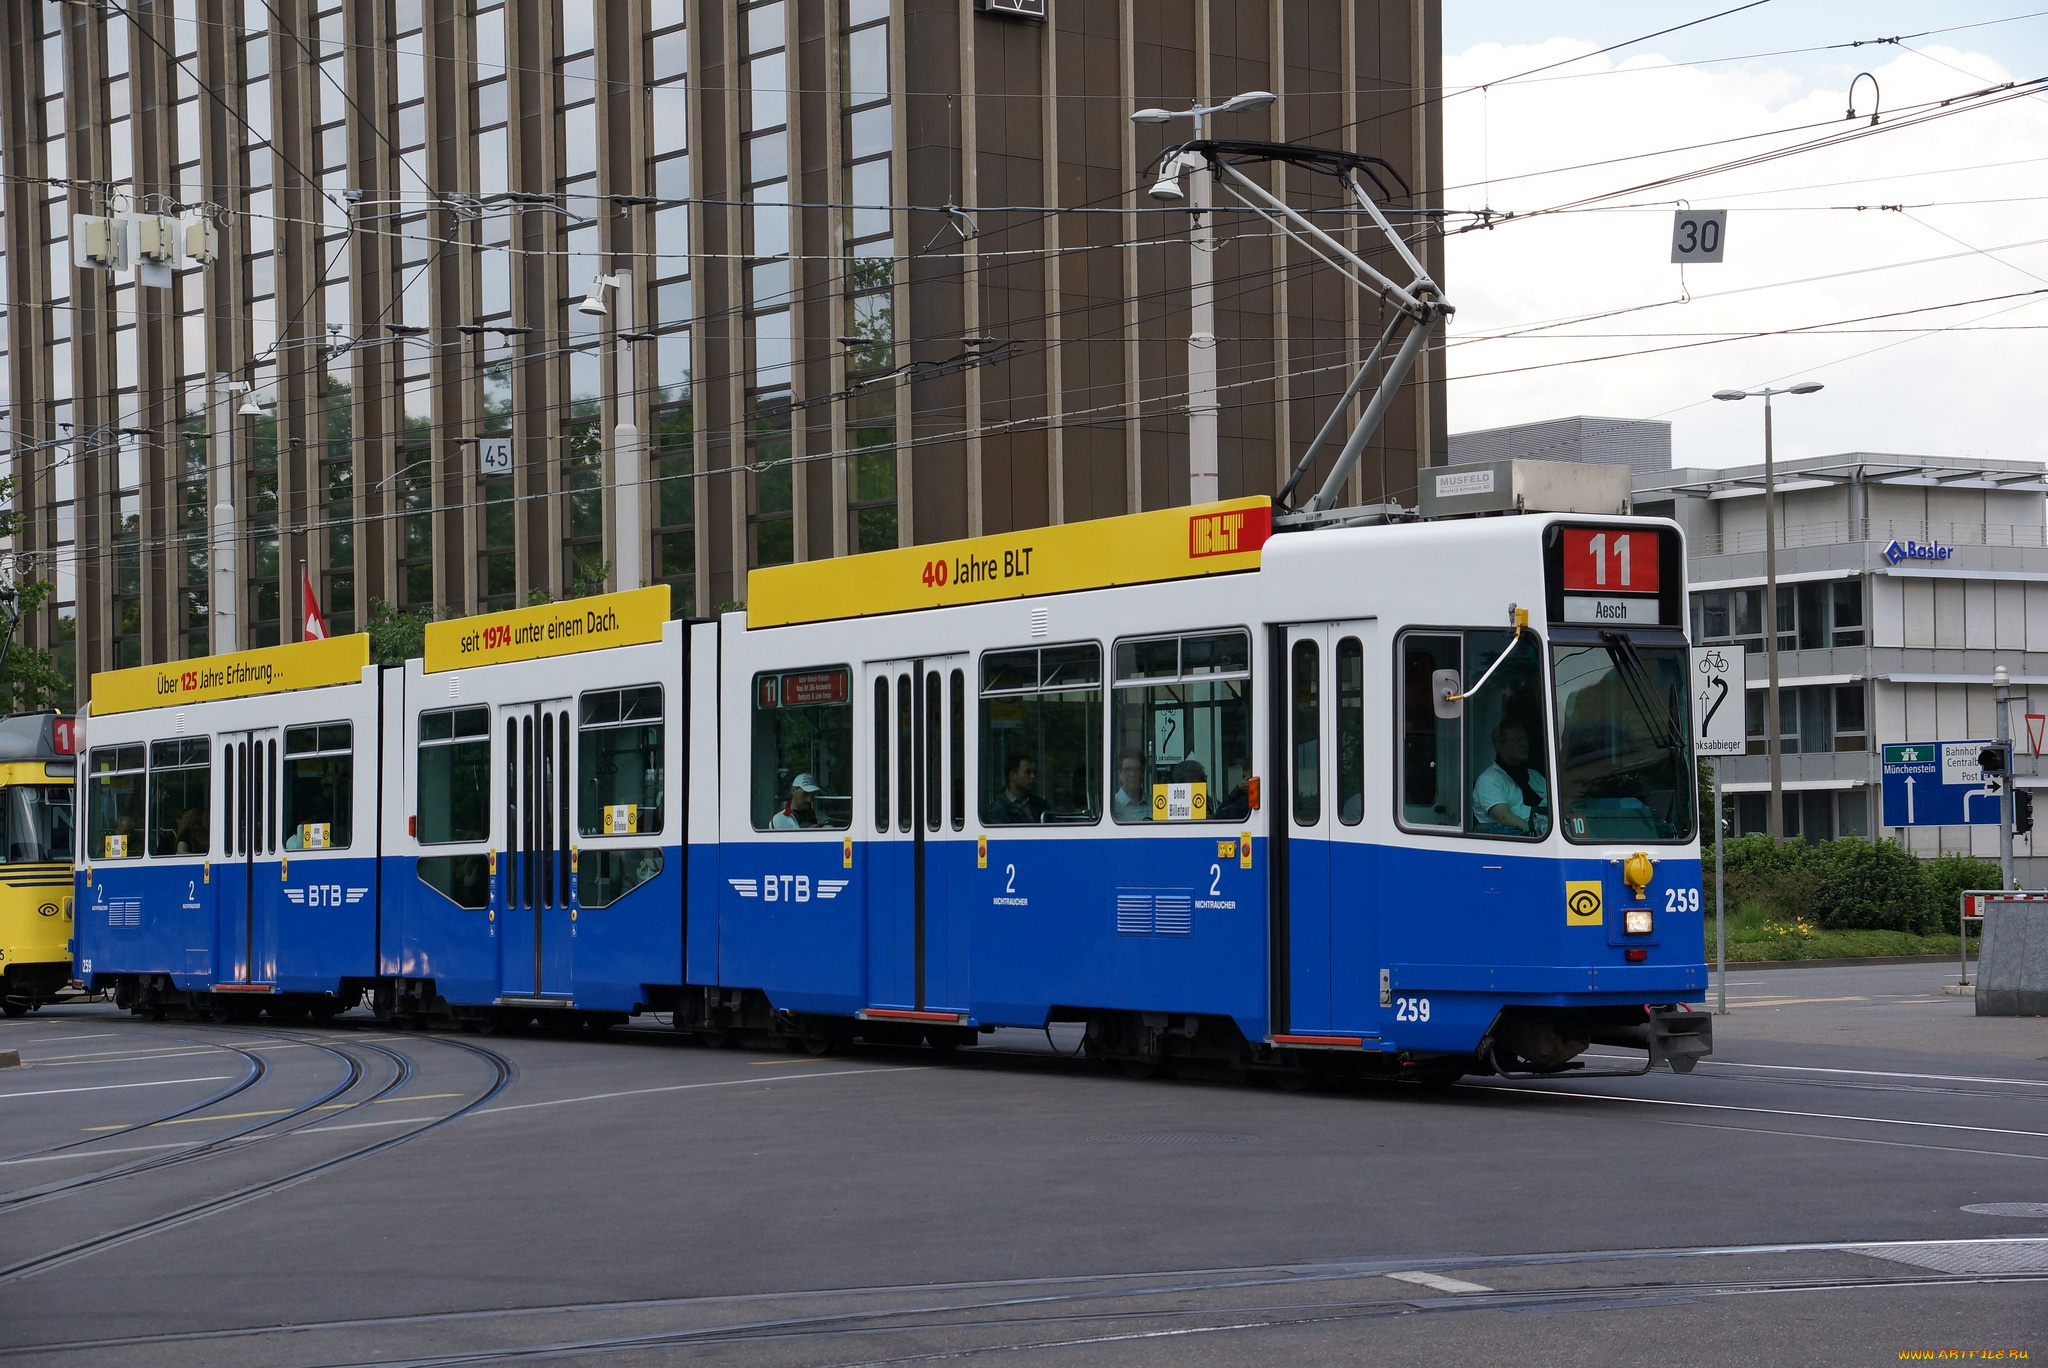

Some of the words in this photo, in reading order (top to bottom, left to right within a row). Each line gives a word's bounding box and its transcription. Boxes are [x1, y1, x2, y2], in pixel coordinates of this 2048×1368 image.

[1678, 220, 1719, 253] 30
[485, 445, 508, 467] 45
[1440, 474, 1490, 486] MUSFELD
[1193, 513, 1244, 555] BLT
[1589, 533, 1631, 586] 11
[1906, 540, 1954, 559] Basler
[922, 560, 948, 588] 40
[953, 554, 998, 585] Jahre
[1004, 547, 1033, 578] BLT
[1595, 601, 1627, 619] Aesch
[461, 630, 480, 653] seit
[483, 625, 511, 649] 1974
[515, 622, 544, 645] unter
[548, 616, 582, 639] einem
[587, 607, 619, 633] Dach.
[157, 672, 178, 695] Über
[181, 671, 198, 691] 125
[200, 668, 223, 689] Jahre
[765, 680, 776, 702] 11
[1696, 740, 1741, 752] nksabbieger
[1946, 746, 1977, 756] Bahnhof
[1884, 764, 1936, 774] Münchenstein
[1947, 758, 1979, 767] Centralb
[1962, 772, 1978, 781] Post
[1174, 787, 1186, 799] ohne
[1169, 804, 1190, 816] Billeteur
[1573, 817, 1585, 834] 10
[1006, 863, 1016, 893] 2
[1210, 863, 1221, 896] 2
[97, 884, 103, 903] 2
[188, 880, 195, 900] 2
[309, 885, 342, 906] BTB
[764, 875, 810, 902] BTB
[1195, 900, 1236, 909] NICHTRAUCHER
[1665, 888, 1699, 912] 259
[82, 959, 92, 973] 259
[1396, 997, 1430, 1022] 259
